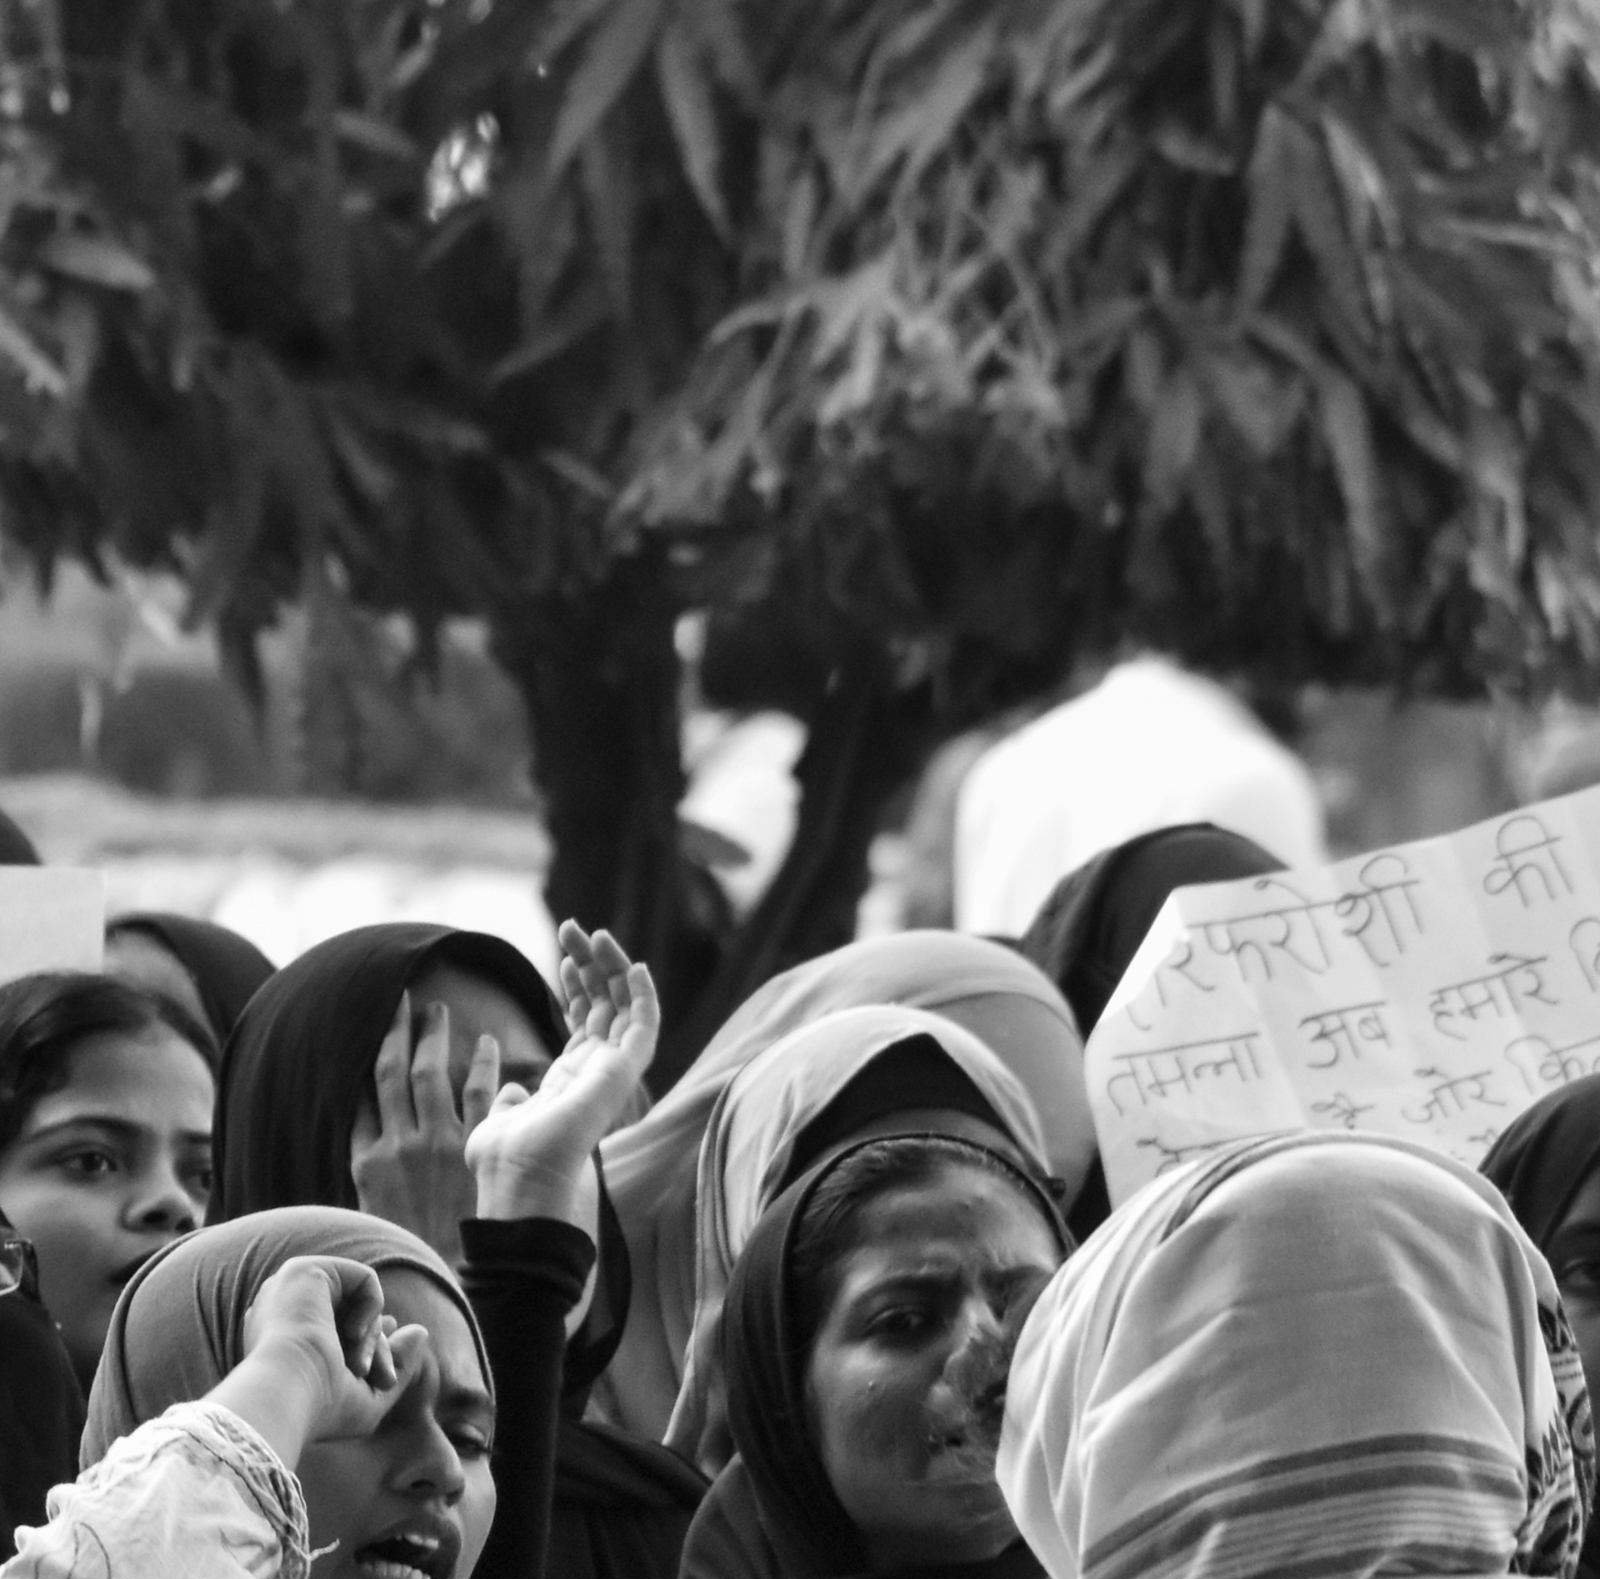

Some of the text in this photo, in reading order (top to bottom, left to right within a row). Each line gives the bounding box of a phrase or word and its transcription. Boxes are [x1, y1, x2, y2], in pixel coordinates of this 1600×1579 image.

[1483, 815, 1575, 908] की
[1298, 1001, 1392, 1070] अब
[1428, 952, 1560, 1041] हमारे
